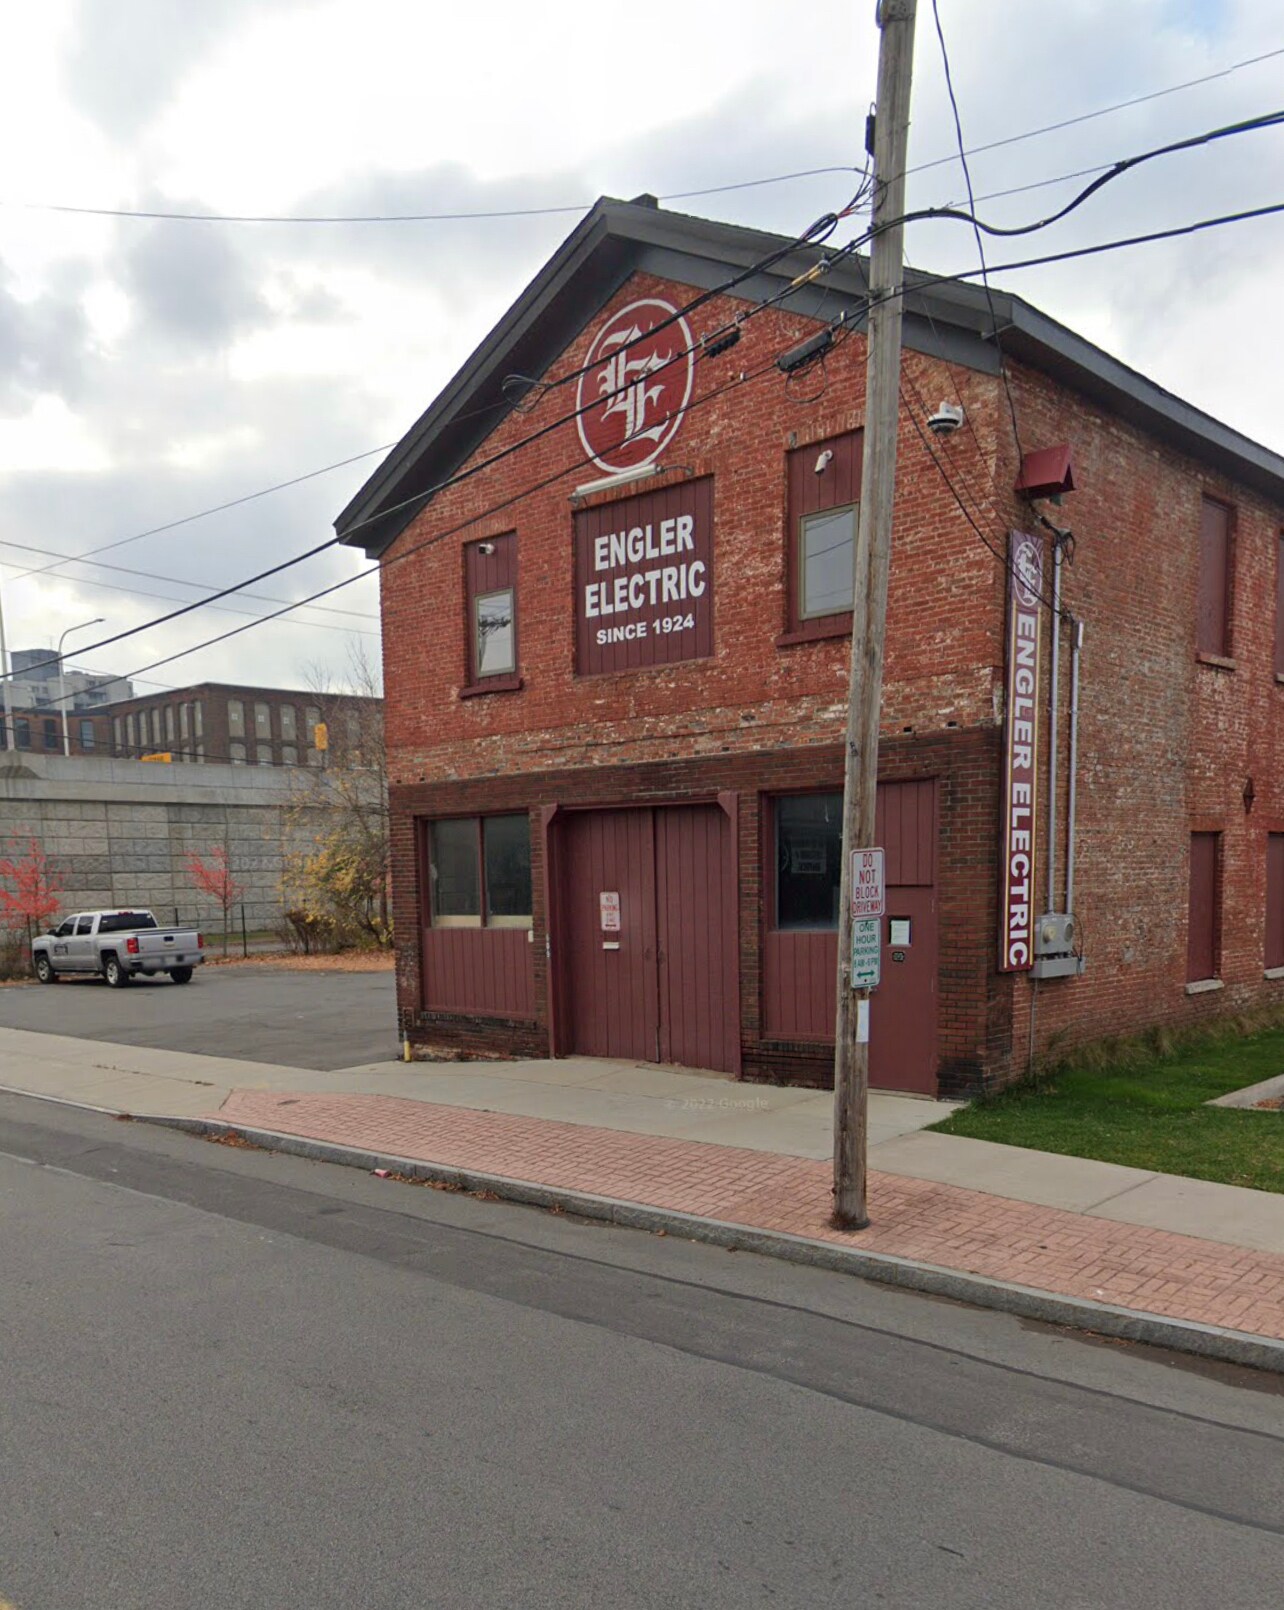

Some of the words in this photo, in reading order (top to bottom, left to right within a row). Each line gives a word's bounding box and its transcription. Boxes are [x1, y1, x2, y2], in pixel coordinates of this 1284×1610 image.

[595, 515, 694, 571] ENGLER
[585, 560, 706, 618] ELECTRIC
[596, 622, 647, 645] SINCE
[652, 613, 695, 634] 1924
[1013, 613, 1036, 769] ENGLER
[863, 853, 872, 868] DO
[859, 869, 876, 885] NOT
[1009, 782, 1031, 966] ELECTRIC
[856, 885, 879, 899] BLOCK
[853, 900, 881, 913] DRIVEWAY
[859, 922, 875, 932] ONE
[856, 934, 877, 944] HOUR
[853, 945, 879, 956] PARKING
